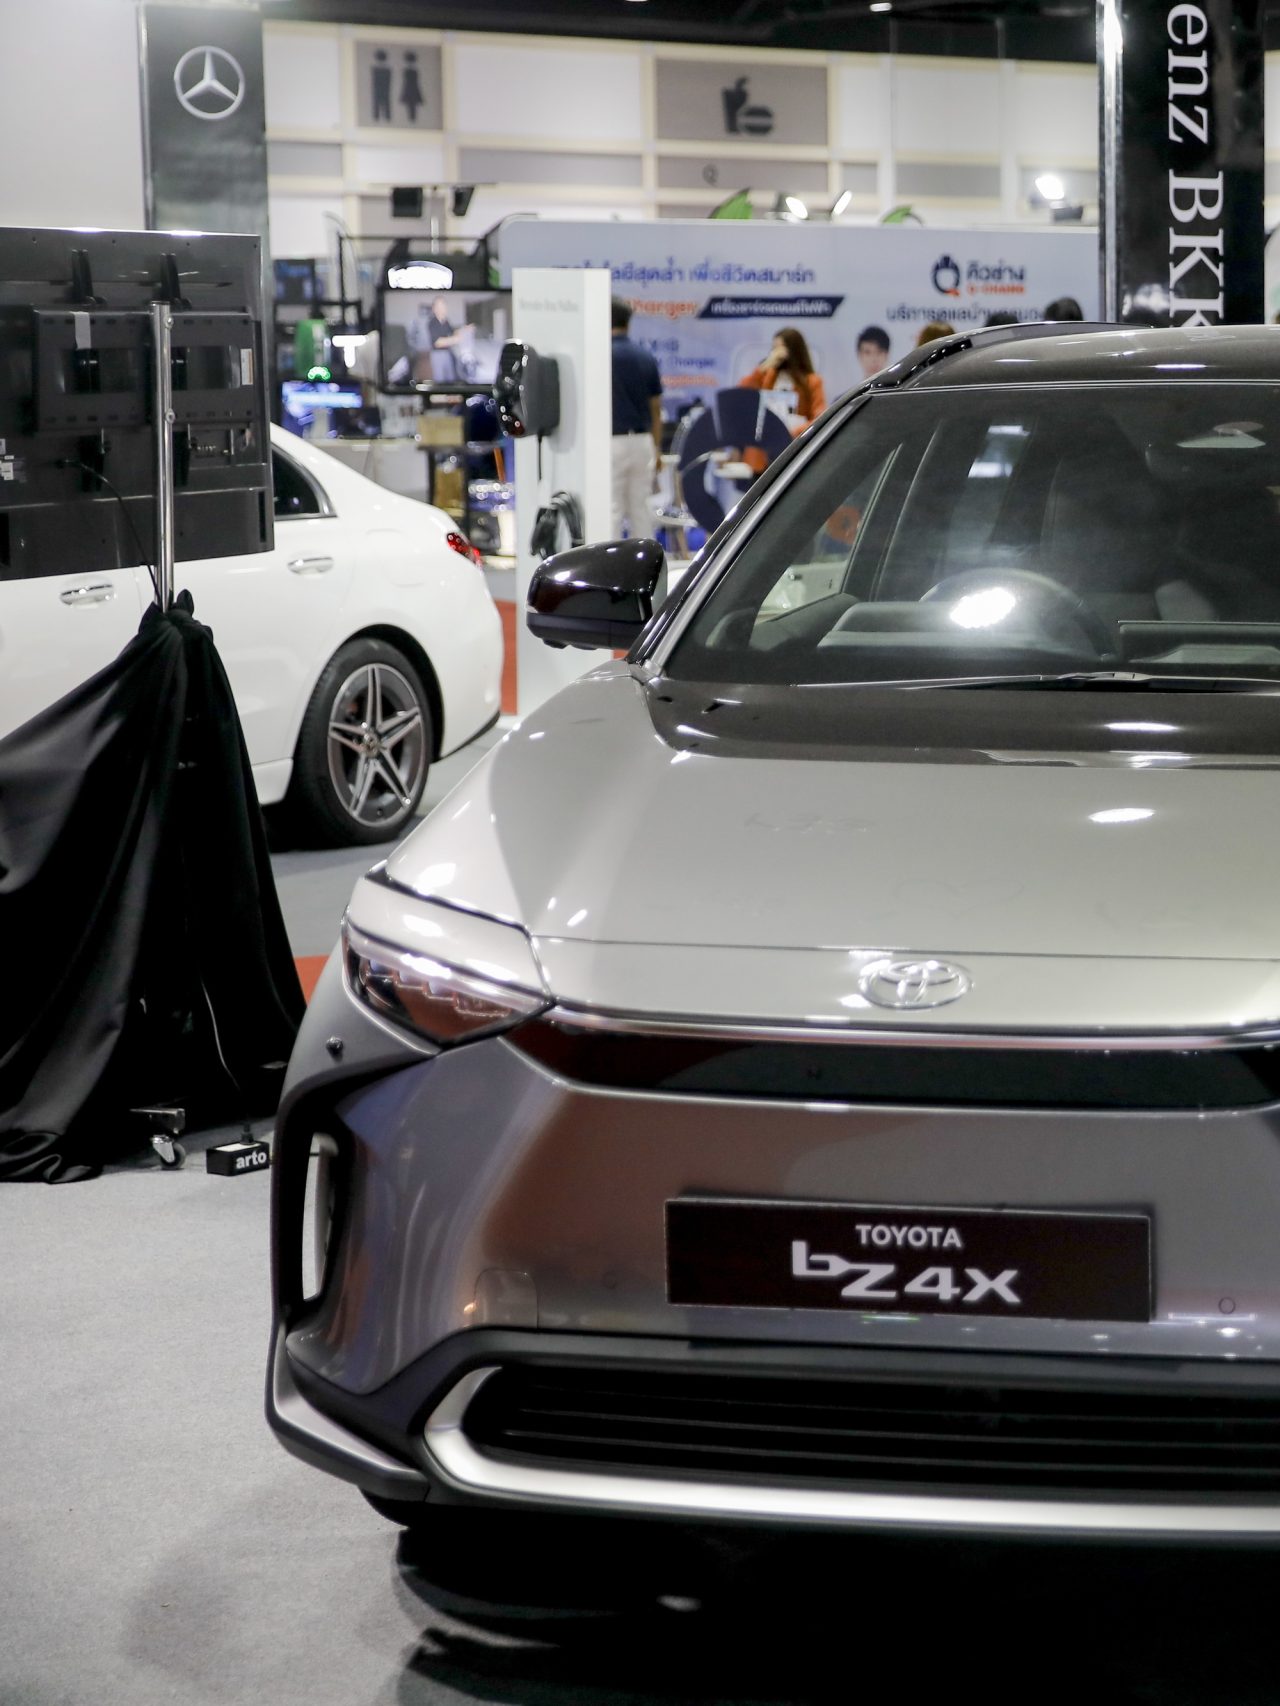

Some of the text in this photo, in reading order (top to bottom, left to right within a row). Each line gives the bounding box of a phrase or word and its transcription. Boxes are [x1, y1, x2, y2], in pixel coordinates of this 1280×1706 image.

[1167, 3, 1208, 144] enz
[236, 1150, 267, 1169] arto
[855, 1225, 963, 1248] TOYOTA
